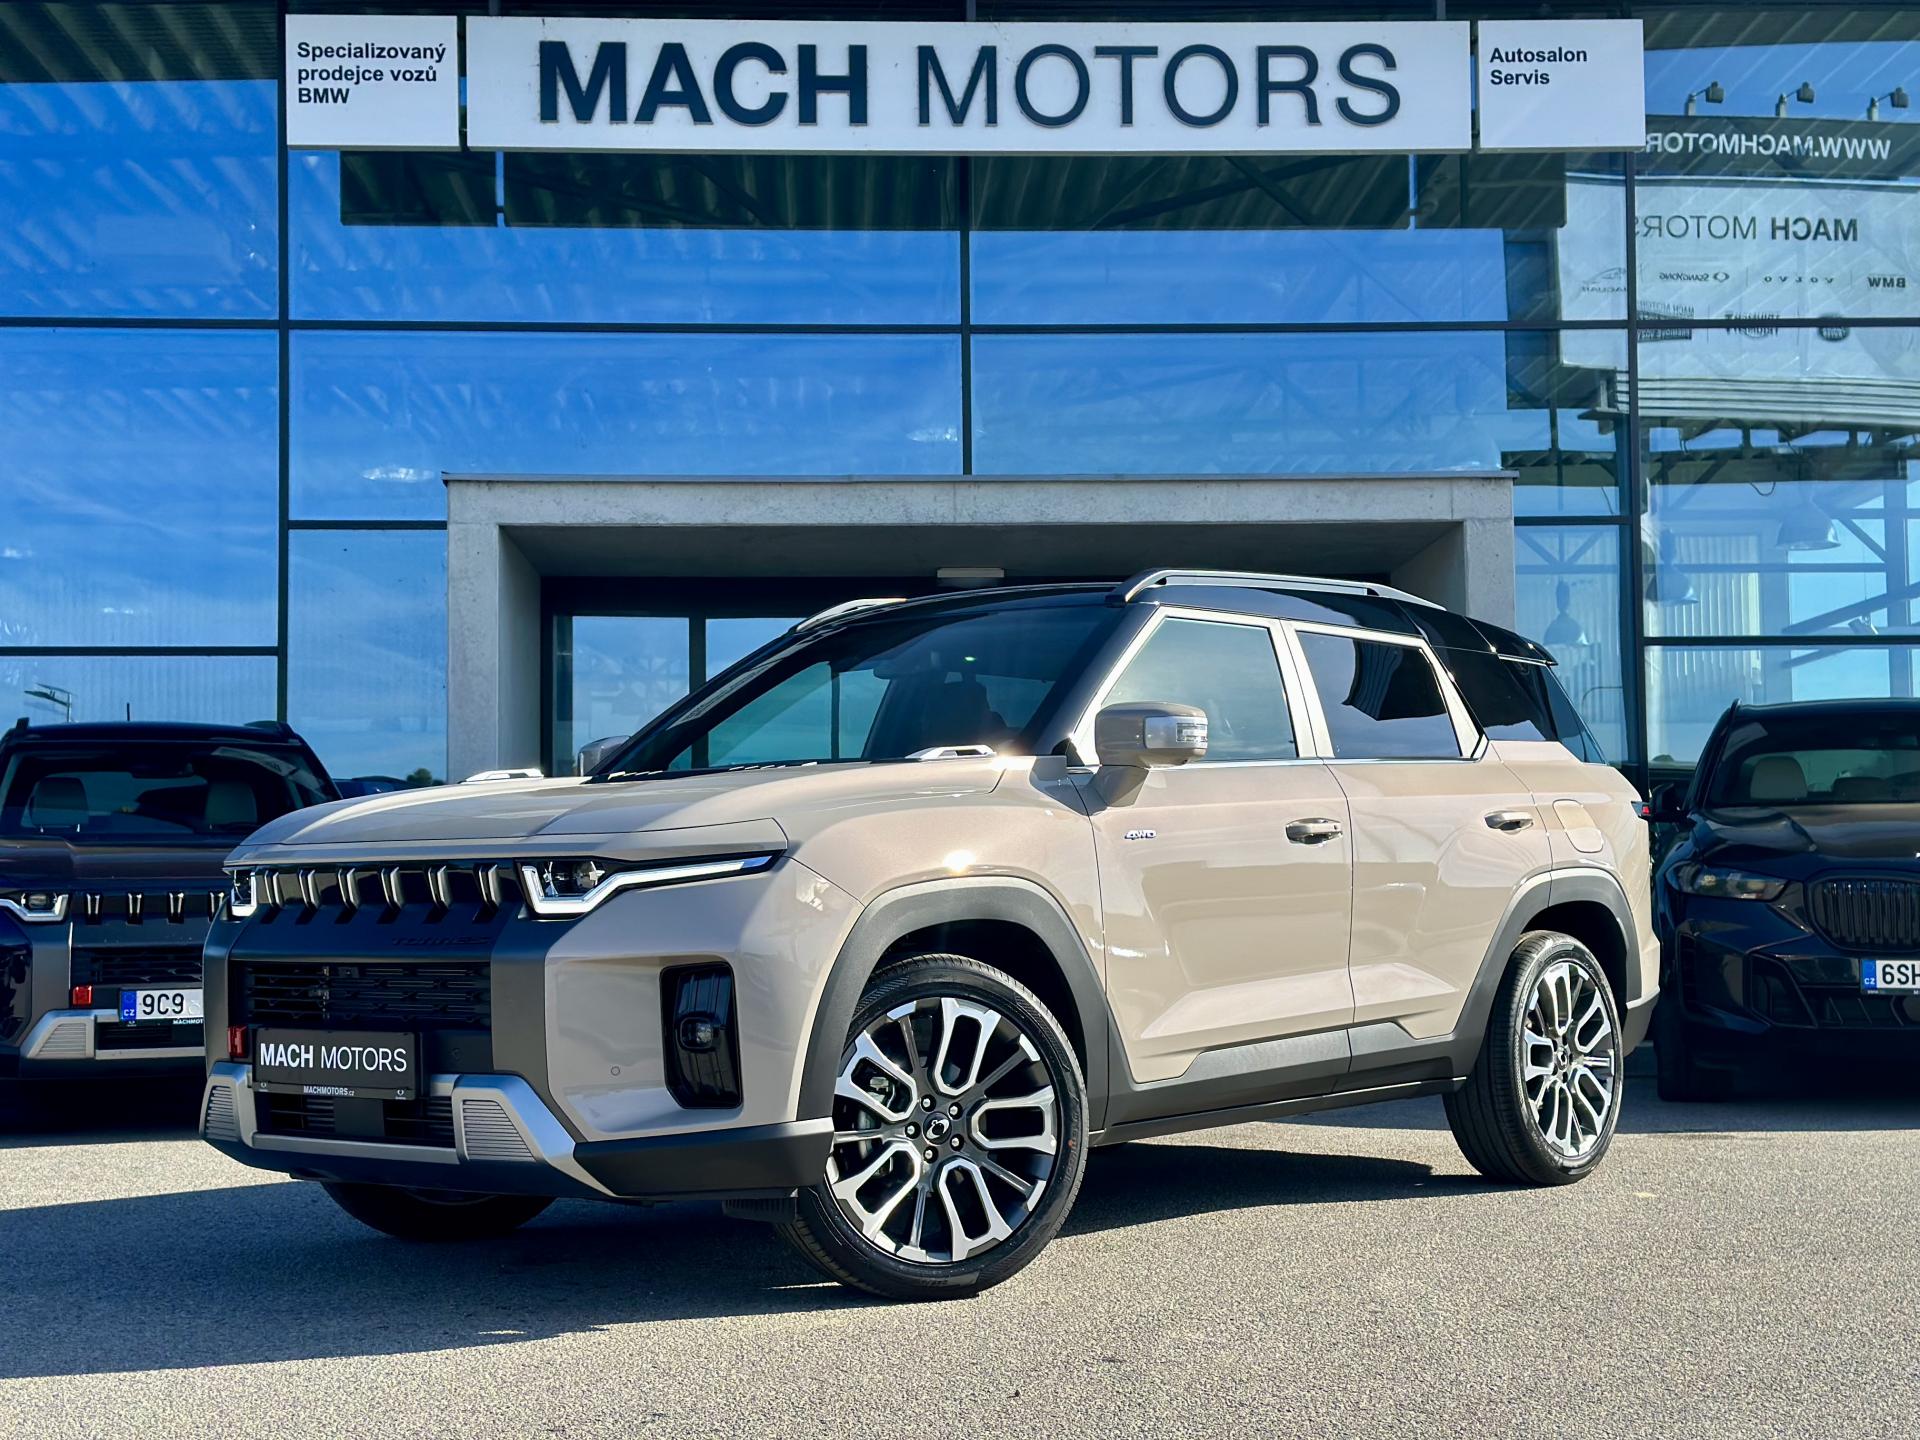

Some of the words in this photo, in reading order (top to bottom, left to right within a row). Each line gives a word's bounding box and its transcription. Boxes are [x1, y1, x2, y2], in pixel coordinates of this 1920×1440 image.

[297, 41, 446, 63] Specializovaný
[1490, 46, 1587, 63] Autosalon
[298, 65, 384, 85] prodejce
[390, 65, 437, 82] vozů
[1490, 69, 1550, 85] Servis
[539, 40, 867, 126] MACH
[917, 43, 1401, 128] MOTORS
[298, 88, 350, 104] BMW
[1124, 829, 1156, 840] 4WD
[1864, 977, 1875, 985] CZ
[142, 993, 184, 1015] 9C9
[260, 1043, 314, 1068] MACH
[320, 1046, 407, 1072] MOTORS
[303, 1086, 355, 1097] MACHMOTORS.cz
